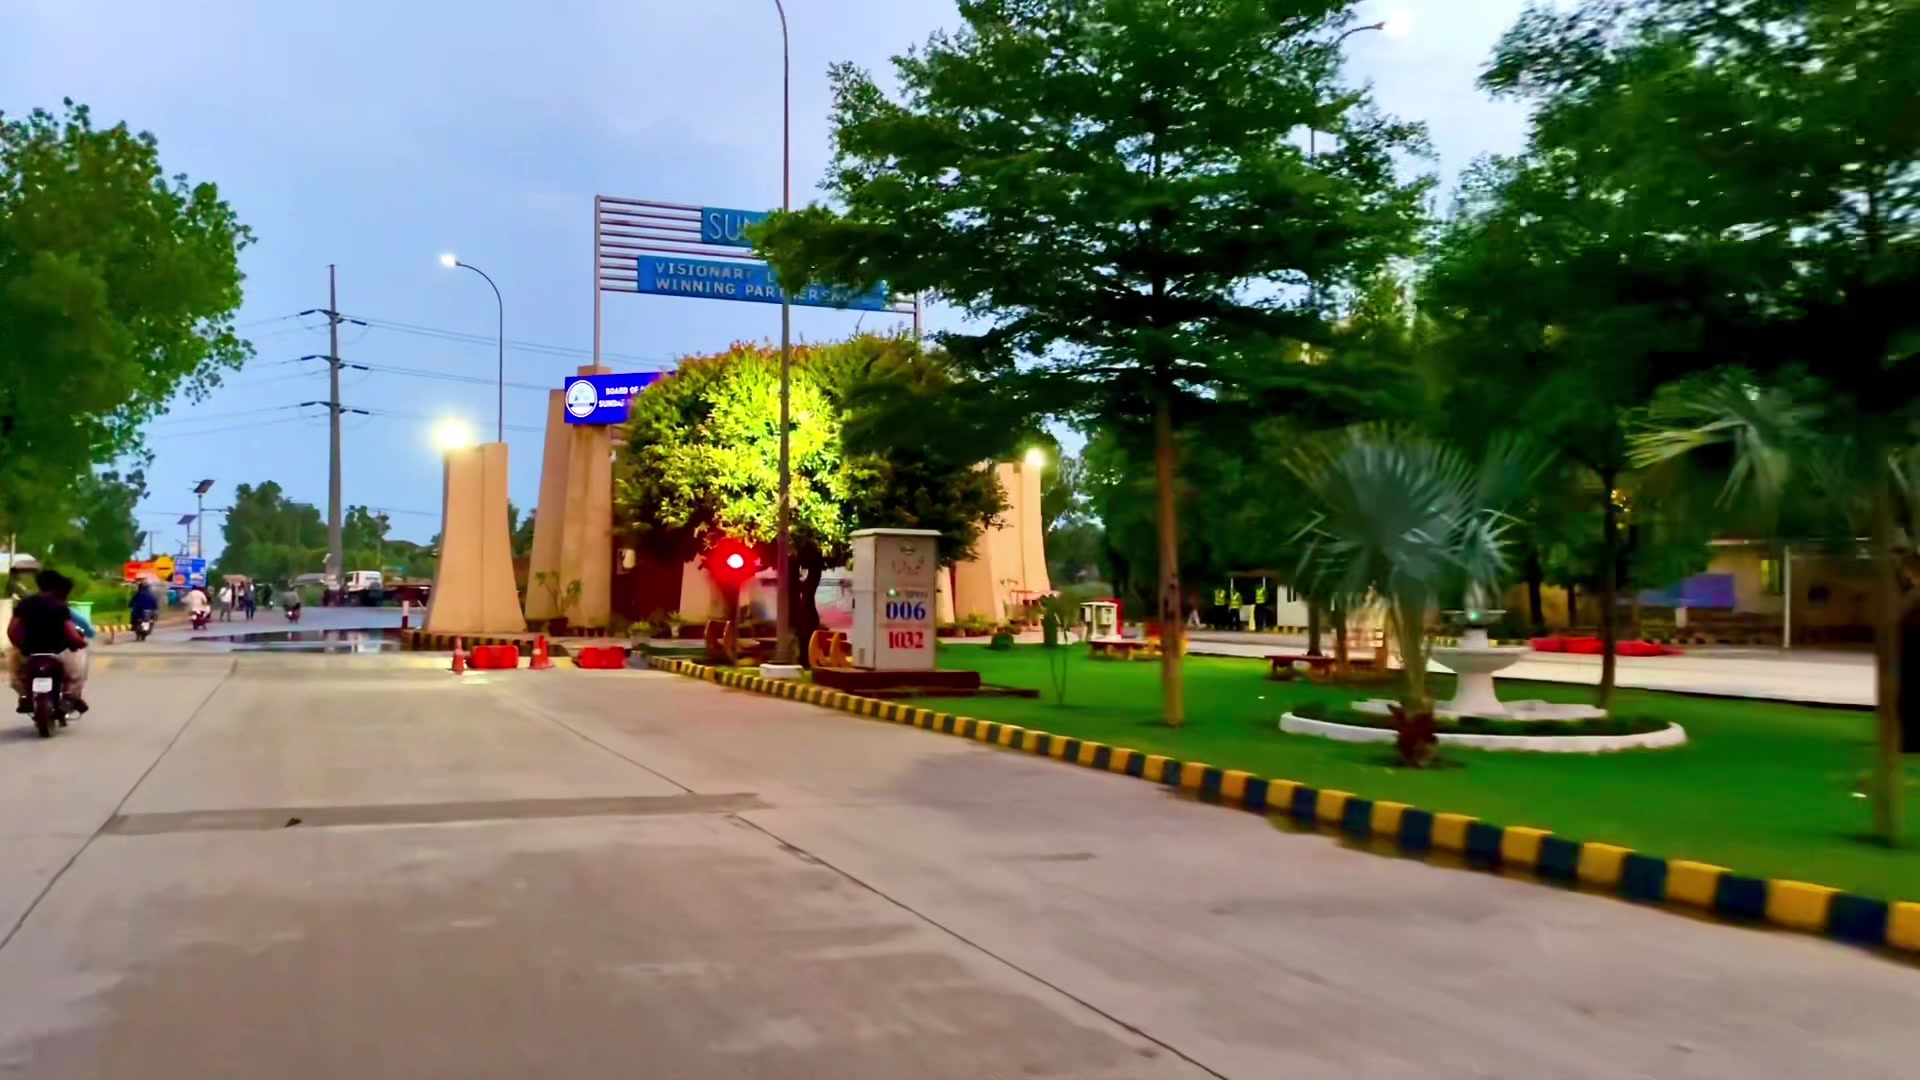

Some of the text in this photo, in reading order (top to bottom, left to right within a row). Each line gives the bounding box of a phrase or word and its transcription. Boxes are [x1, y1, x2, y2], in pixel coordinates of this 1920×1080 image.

[655, 262, 752, 280] VISIONAR
[655, 278, 736, 295] WINNING
[886, 601, 926, 621] 006
[889, 631, 924, 649] 1032
